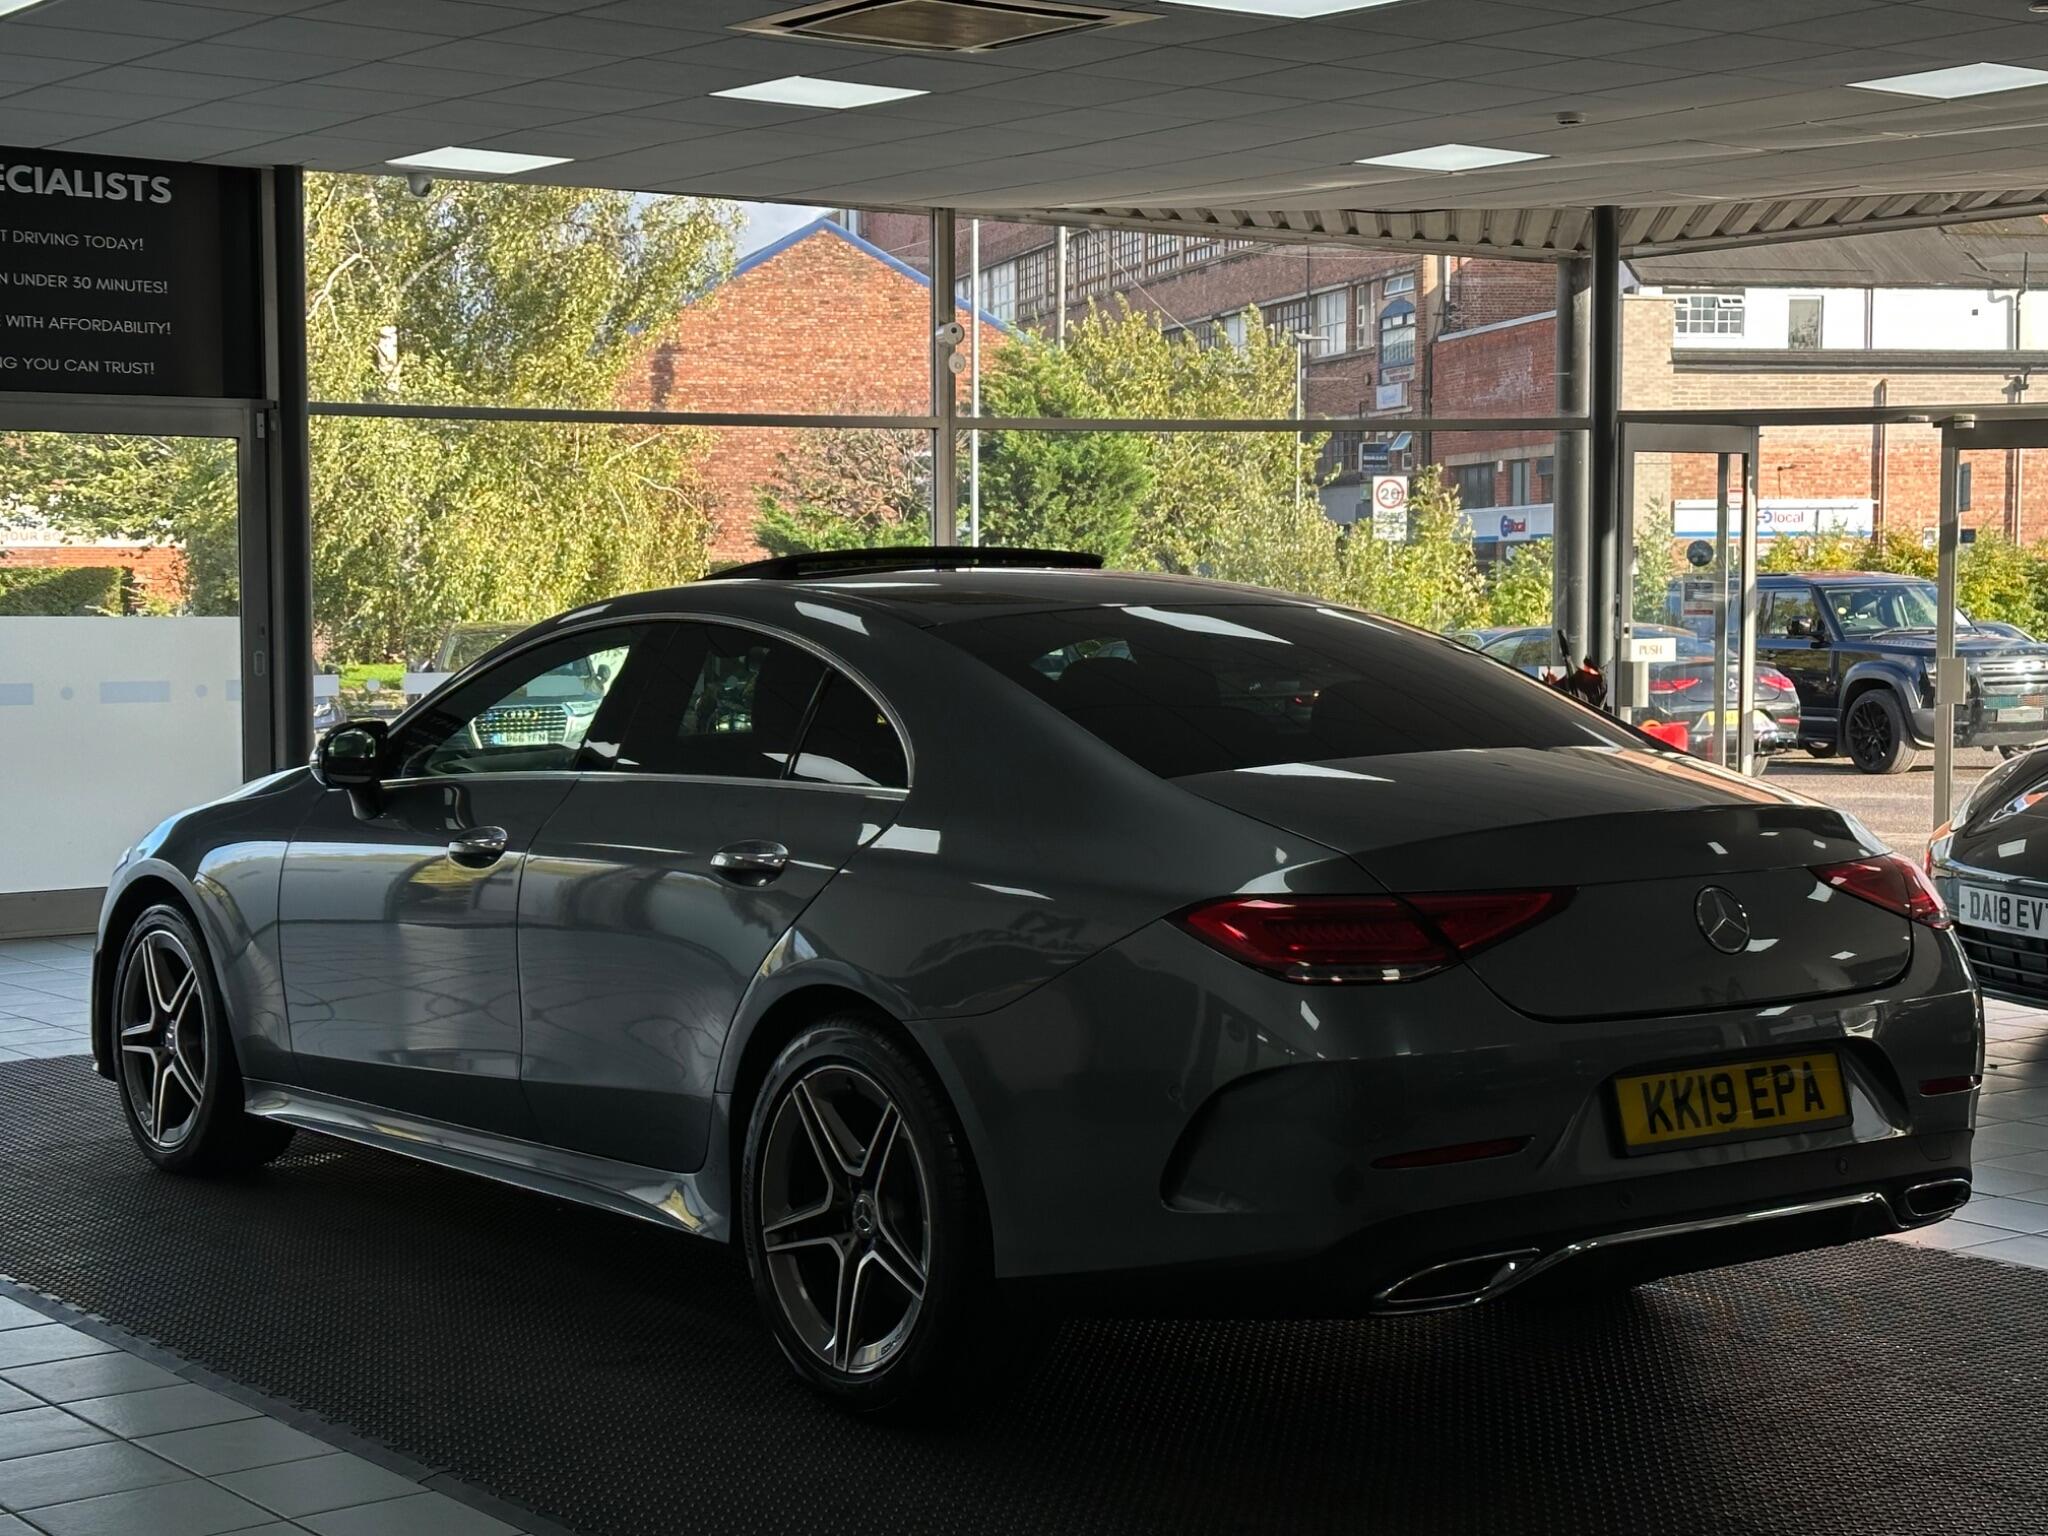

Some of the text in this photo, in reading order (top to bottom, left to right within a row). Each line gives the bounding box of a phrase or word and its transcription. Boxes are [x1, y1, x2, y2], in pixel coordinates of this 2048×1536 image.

[13, 230, 79, 247] DRIVING
[84, 234, 144, 251] TODAY!
[13, 273, 68, 288] UNDER
[73, 276, 92, 289] 30
[96, 278, 168, 294] MINUTES!
[5, 314, 172, 335] WITH AFFORDABILITY!
[0, 356, 156, 375] G YOU CAN TRUST!
[1773, 511, 1804, 523] local
[1969, 890, 2048, 931] DA18 EV
[1640, 1060, 1825, 1135] KK19 EPA
